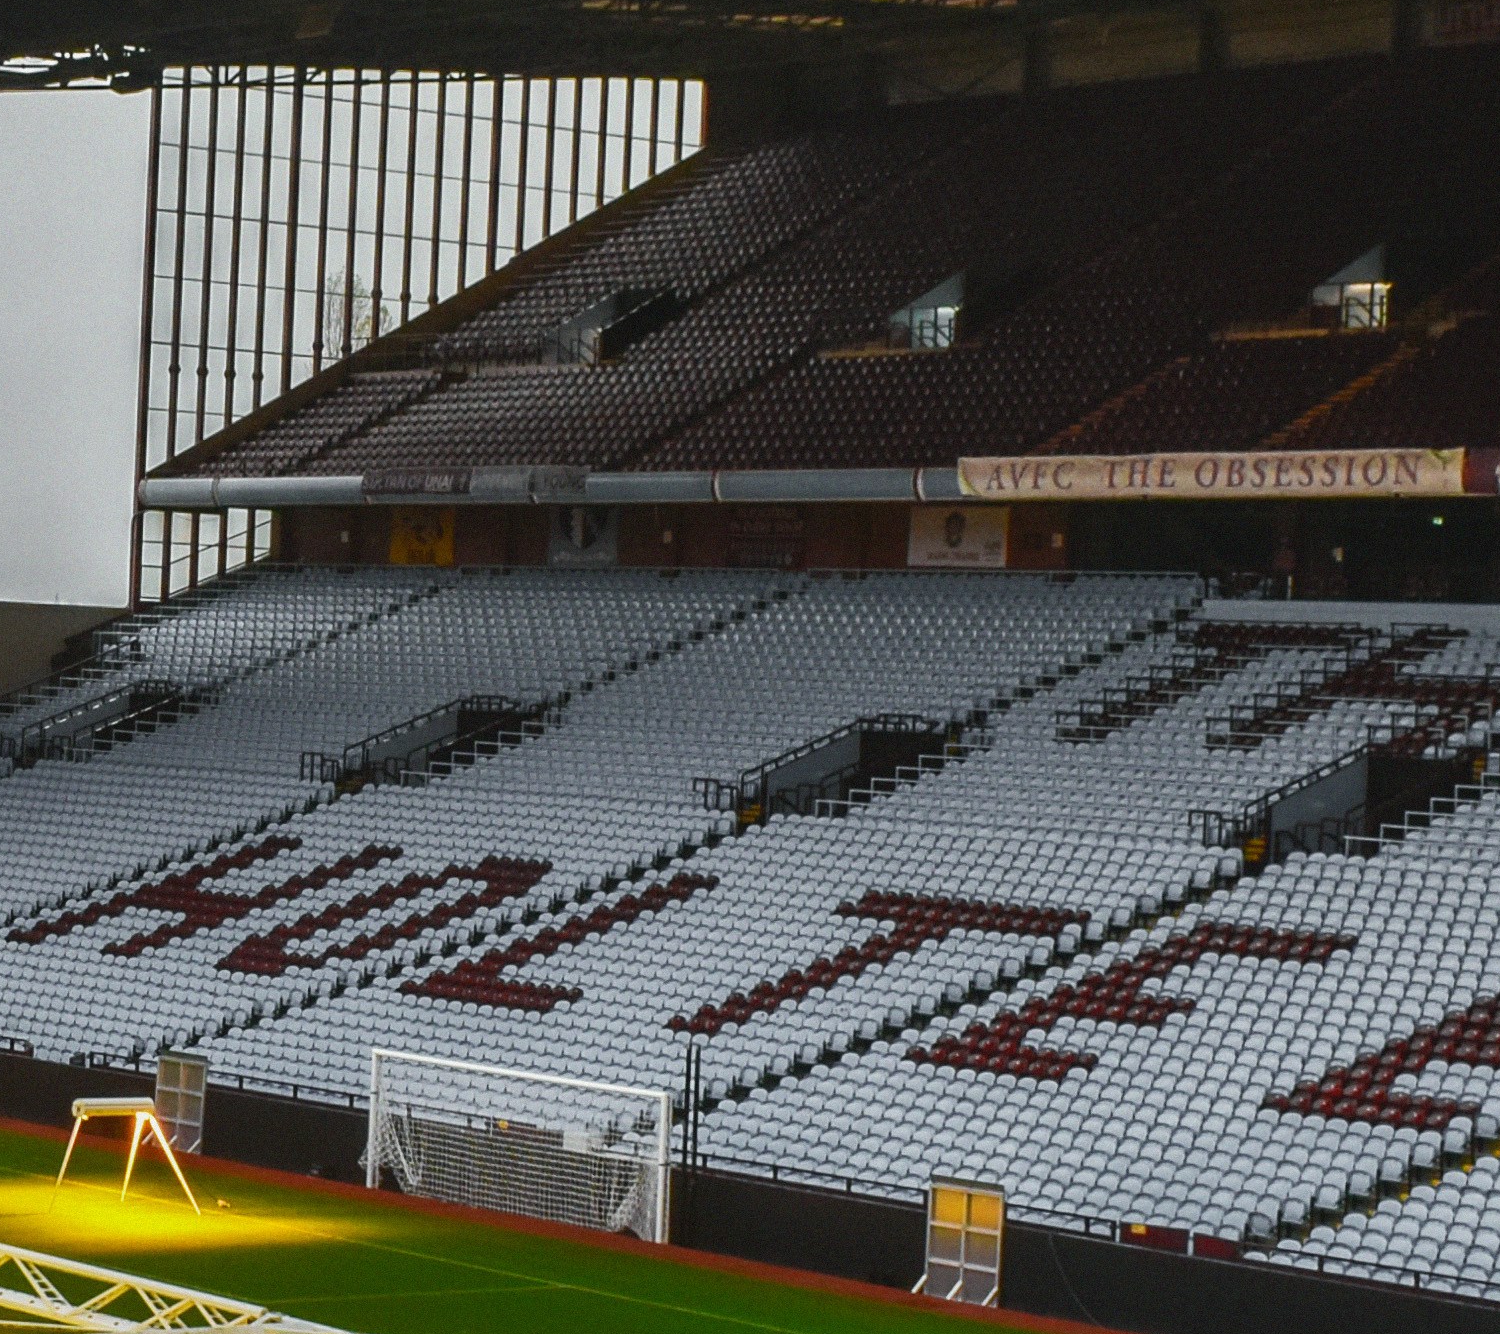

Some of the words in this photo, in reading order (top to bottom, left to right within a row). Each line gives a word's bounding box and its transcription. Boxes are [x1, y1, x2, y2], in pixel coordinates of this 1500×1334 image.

[985, 455, 1077, 492] AVFC
[1102, 457, 1177, 491] THE
[1193, 452, 1424, 490] OBSESSION
[3, 834, 1357, 1080] HOLTE
